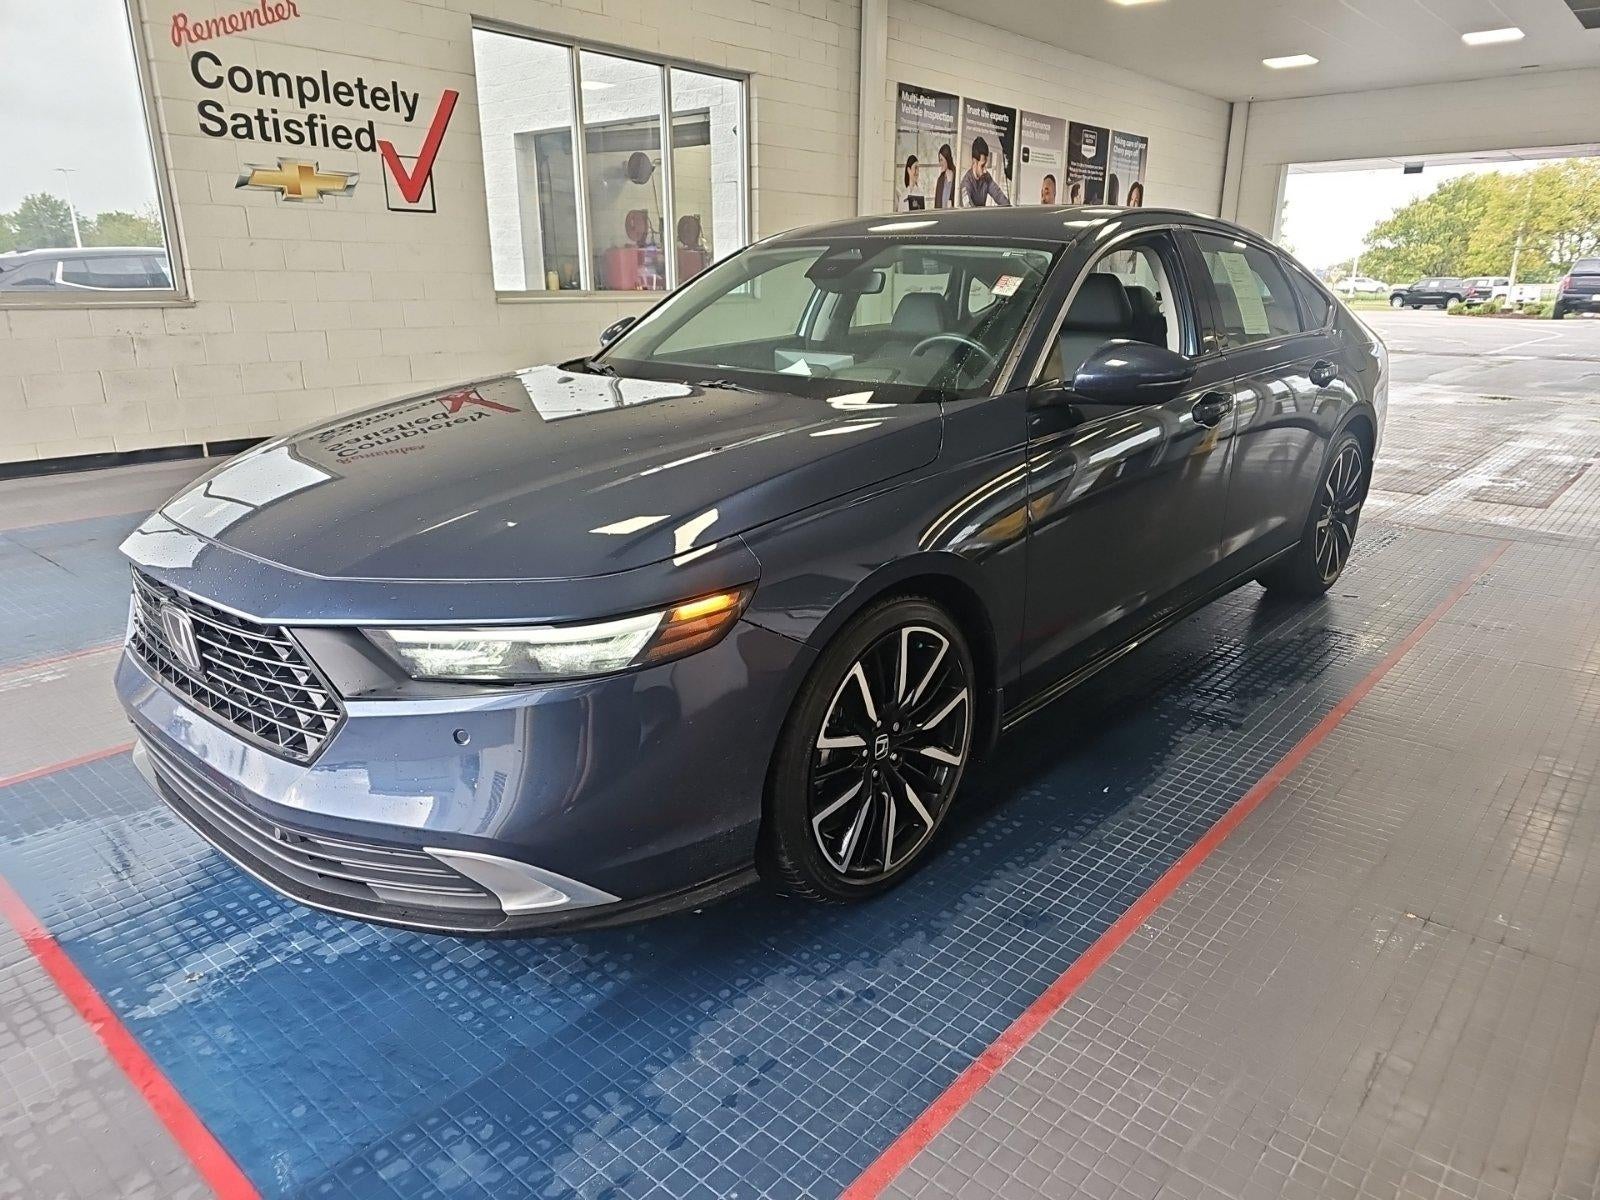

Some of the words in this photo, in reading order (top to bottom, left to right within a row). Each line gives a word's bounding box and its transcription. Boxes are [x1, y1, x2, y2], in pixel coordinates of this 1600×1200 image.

[171, 0, 301, 47] Remember
[190, 50, 420, 122] Completely
[902, 90, 936, 108] Multi-Point
[197, 98, 378, 153] Satisfied
[901, 102, 923, 117] Vehicle
[923, 108, 954, 123] Inspection
[966, 104, 980, 116] Trust
[980, 107, 990, 119] the
[990, 112, 1010, 123] experts
